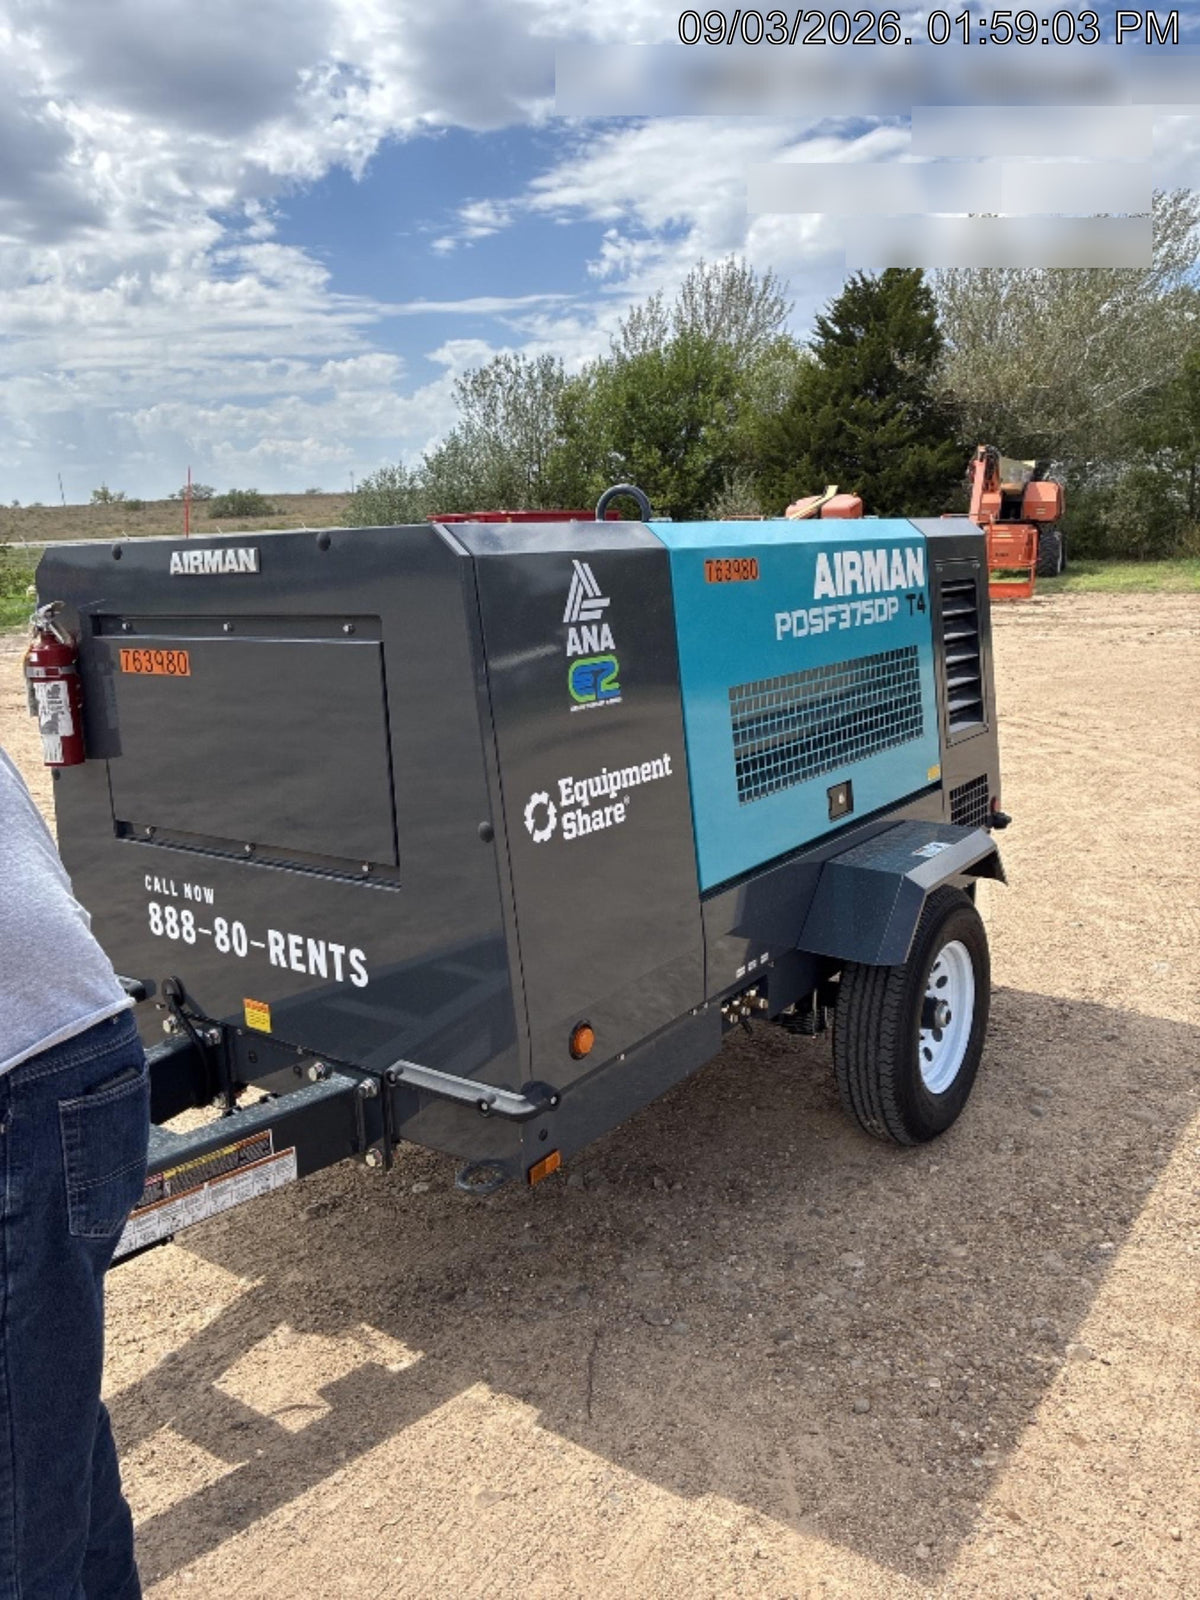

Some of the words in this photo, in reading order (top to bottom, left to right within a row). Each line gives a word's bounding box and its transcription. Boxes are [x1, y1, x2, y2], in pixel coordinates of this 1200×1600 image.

[170, 547, 258, 575] AIRMAN
[705, 558, 758, 583] 763980
[814, 547, 925, 600] AIRMAN
[774, 597, 899, 641] PDSF375DP
[905, 592, 926, 617] T4
[566, 623, 616, 657] ANA
[121, 649, 188, 675] 763980
[557, 752, 673, 807] Equipment
[144, 874, 178, 897] CALL
[183, 882, 214, 905] NOW
[148, 901, 369, 988] 888-80-RENTS
